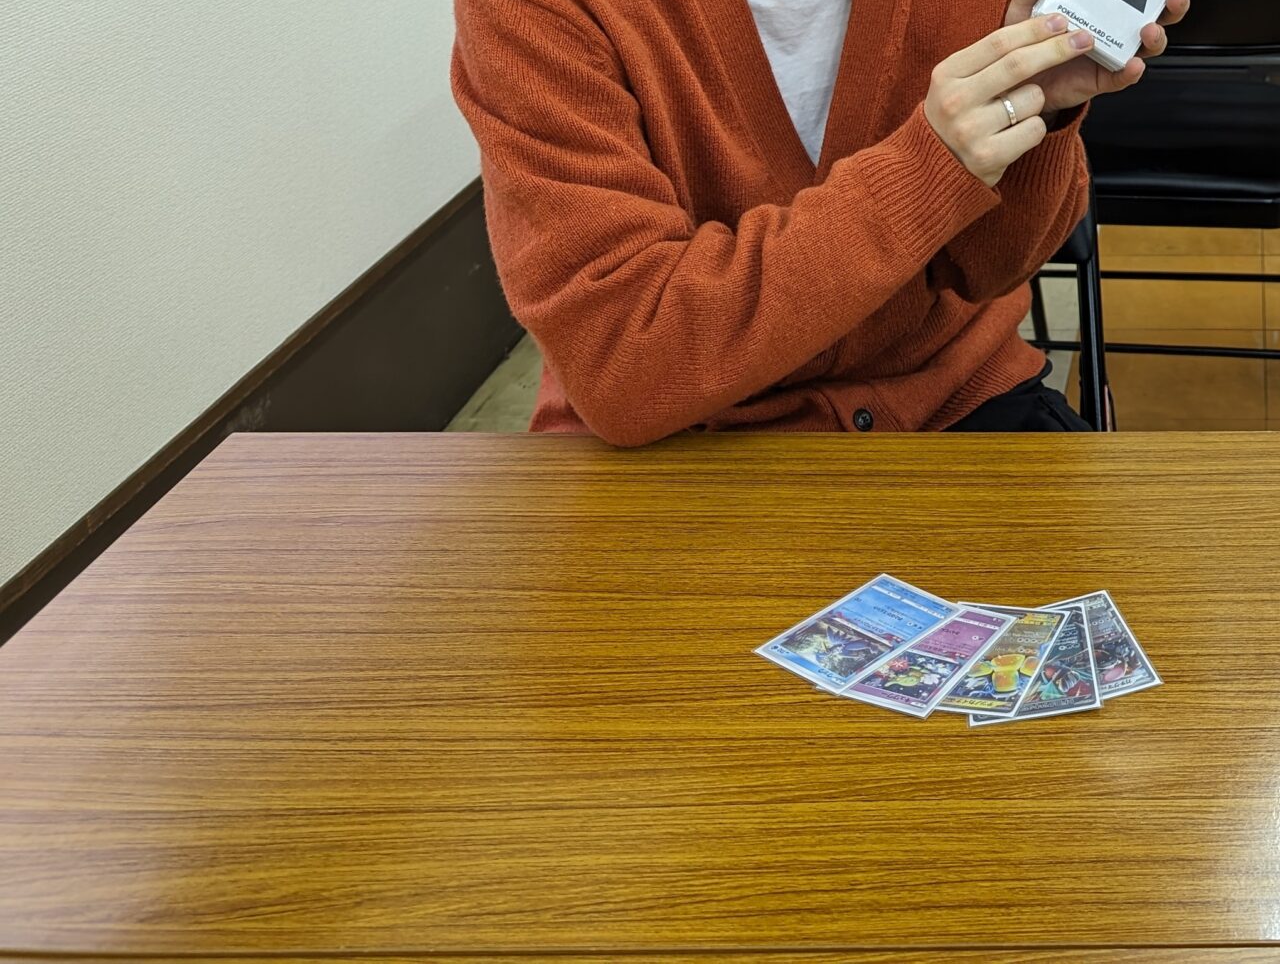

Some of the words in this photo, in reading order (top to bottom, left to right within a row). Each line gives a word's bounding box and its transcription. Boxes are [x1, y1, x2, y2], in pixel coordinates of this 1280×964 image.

[1057, 5, 1089, 27] POKÉMON
[1089, 25, 1106, 38] CARD
[1105, 35, 1124, 49] GAME
